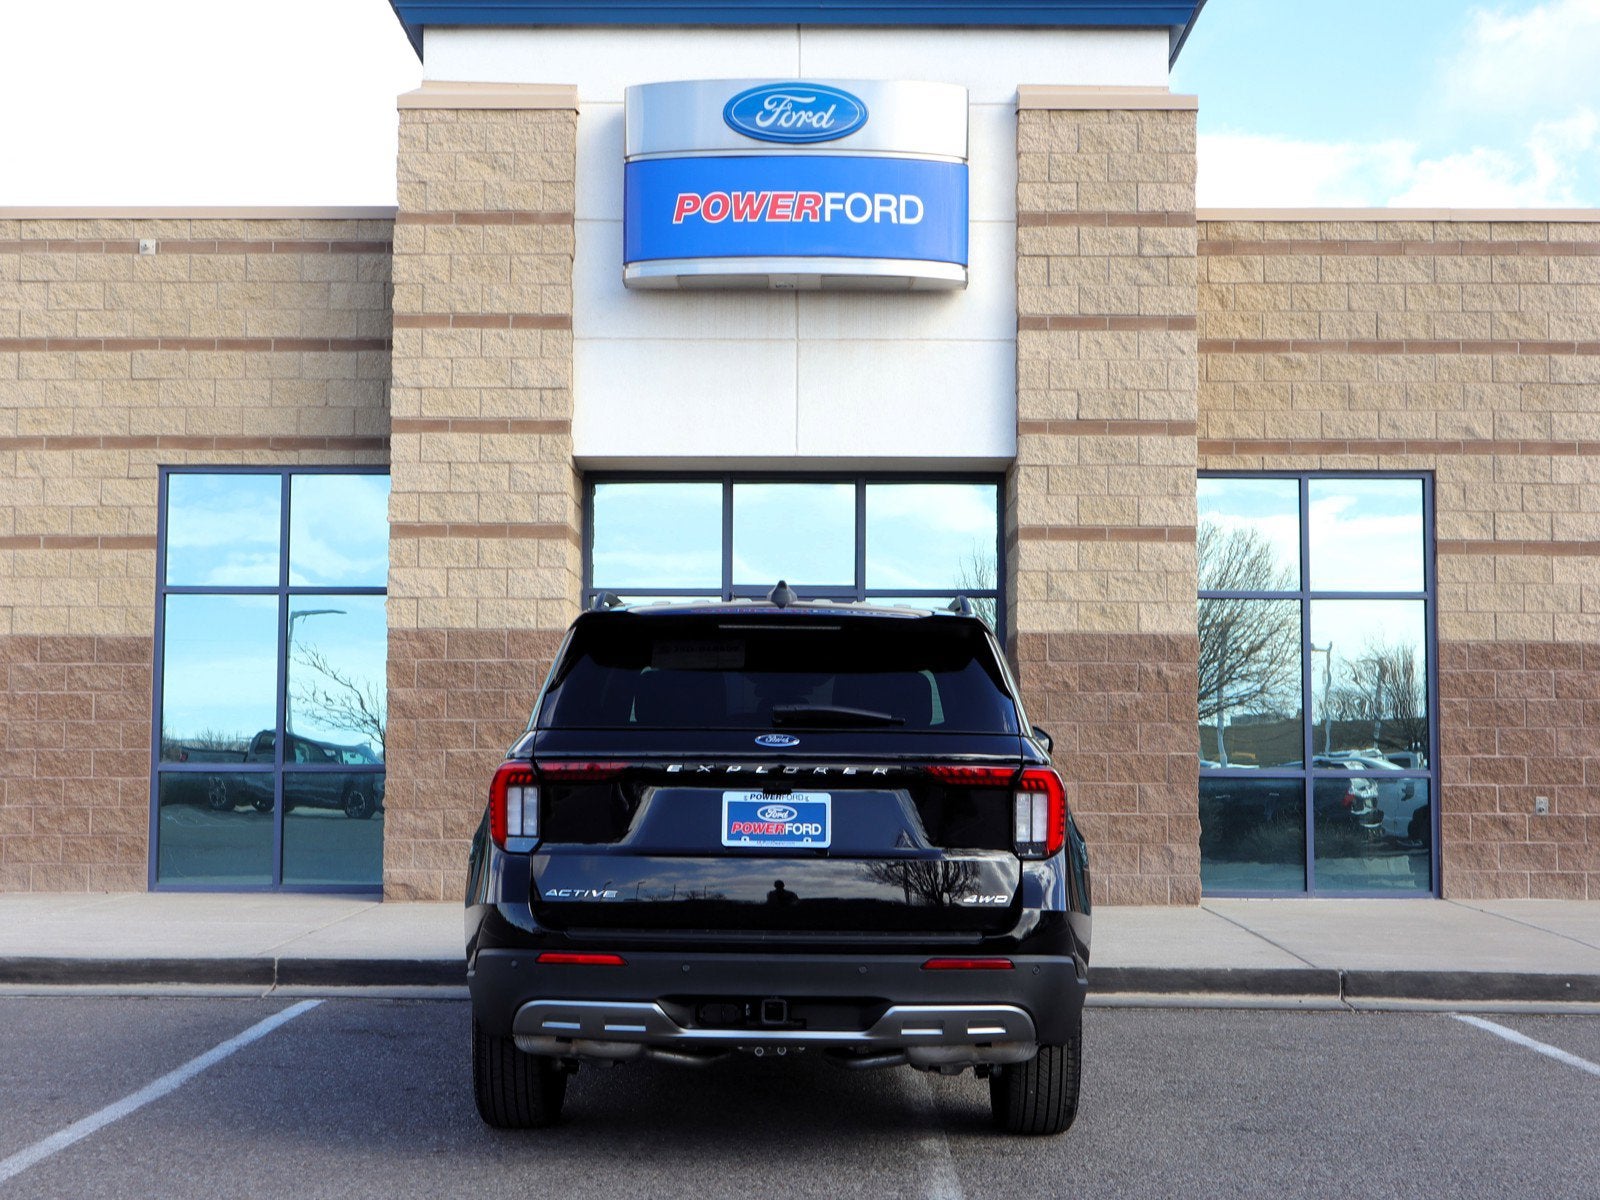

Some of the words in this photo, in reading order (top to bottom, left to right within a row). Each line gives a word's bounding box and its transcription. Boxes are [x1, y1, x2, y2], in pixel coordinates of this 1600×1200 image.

[755, 93, 837, 130] Ford
[672, 190, 924, 225] POWERFORD
[765, 734, 789, 744] Ford
[666, 764, 888, 775] EXPLORER
[765, 807, 789, 819] Ford
[731, 822, 822, 835] POWERFORD
[545, 889, 618, 898] ACTIVE
[963, 894, 1008, 903] 4WD
